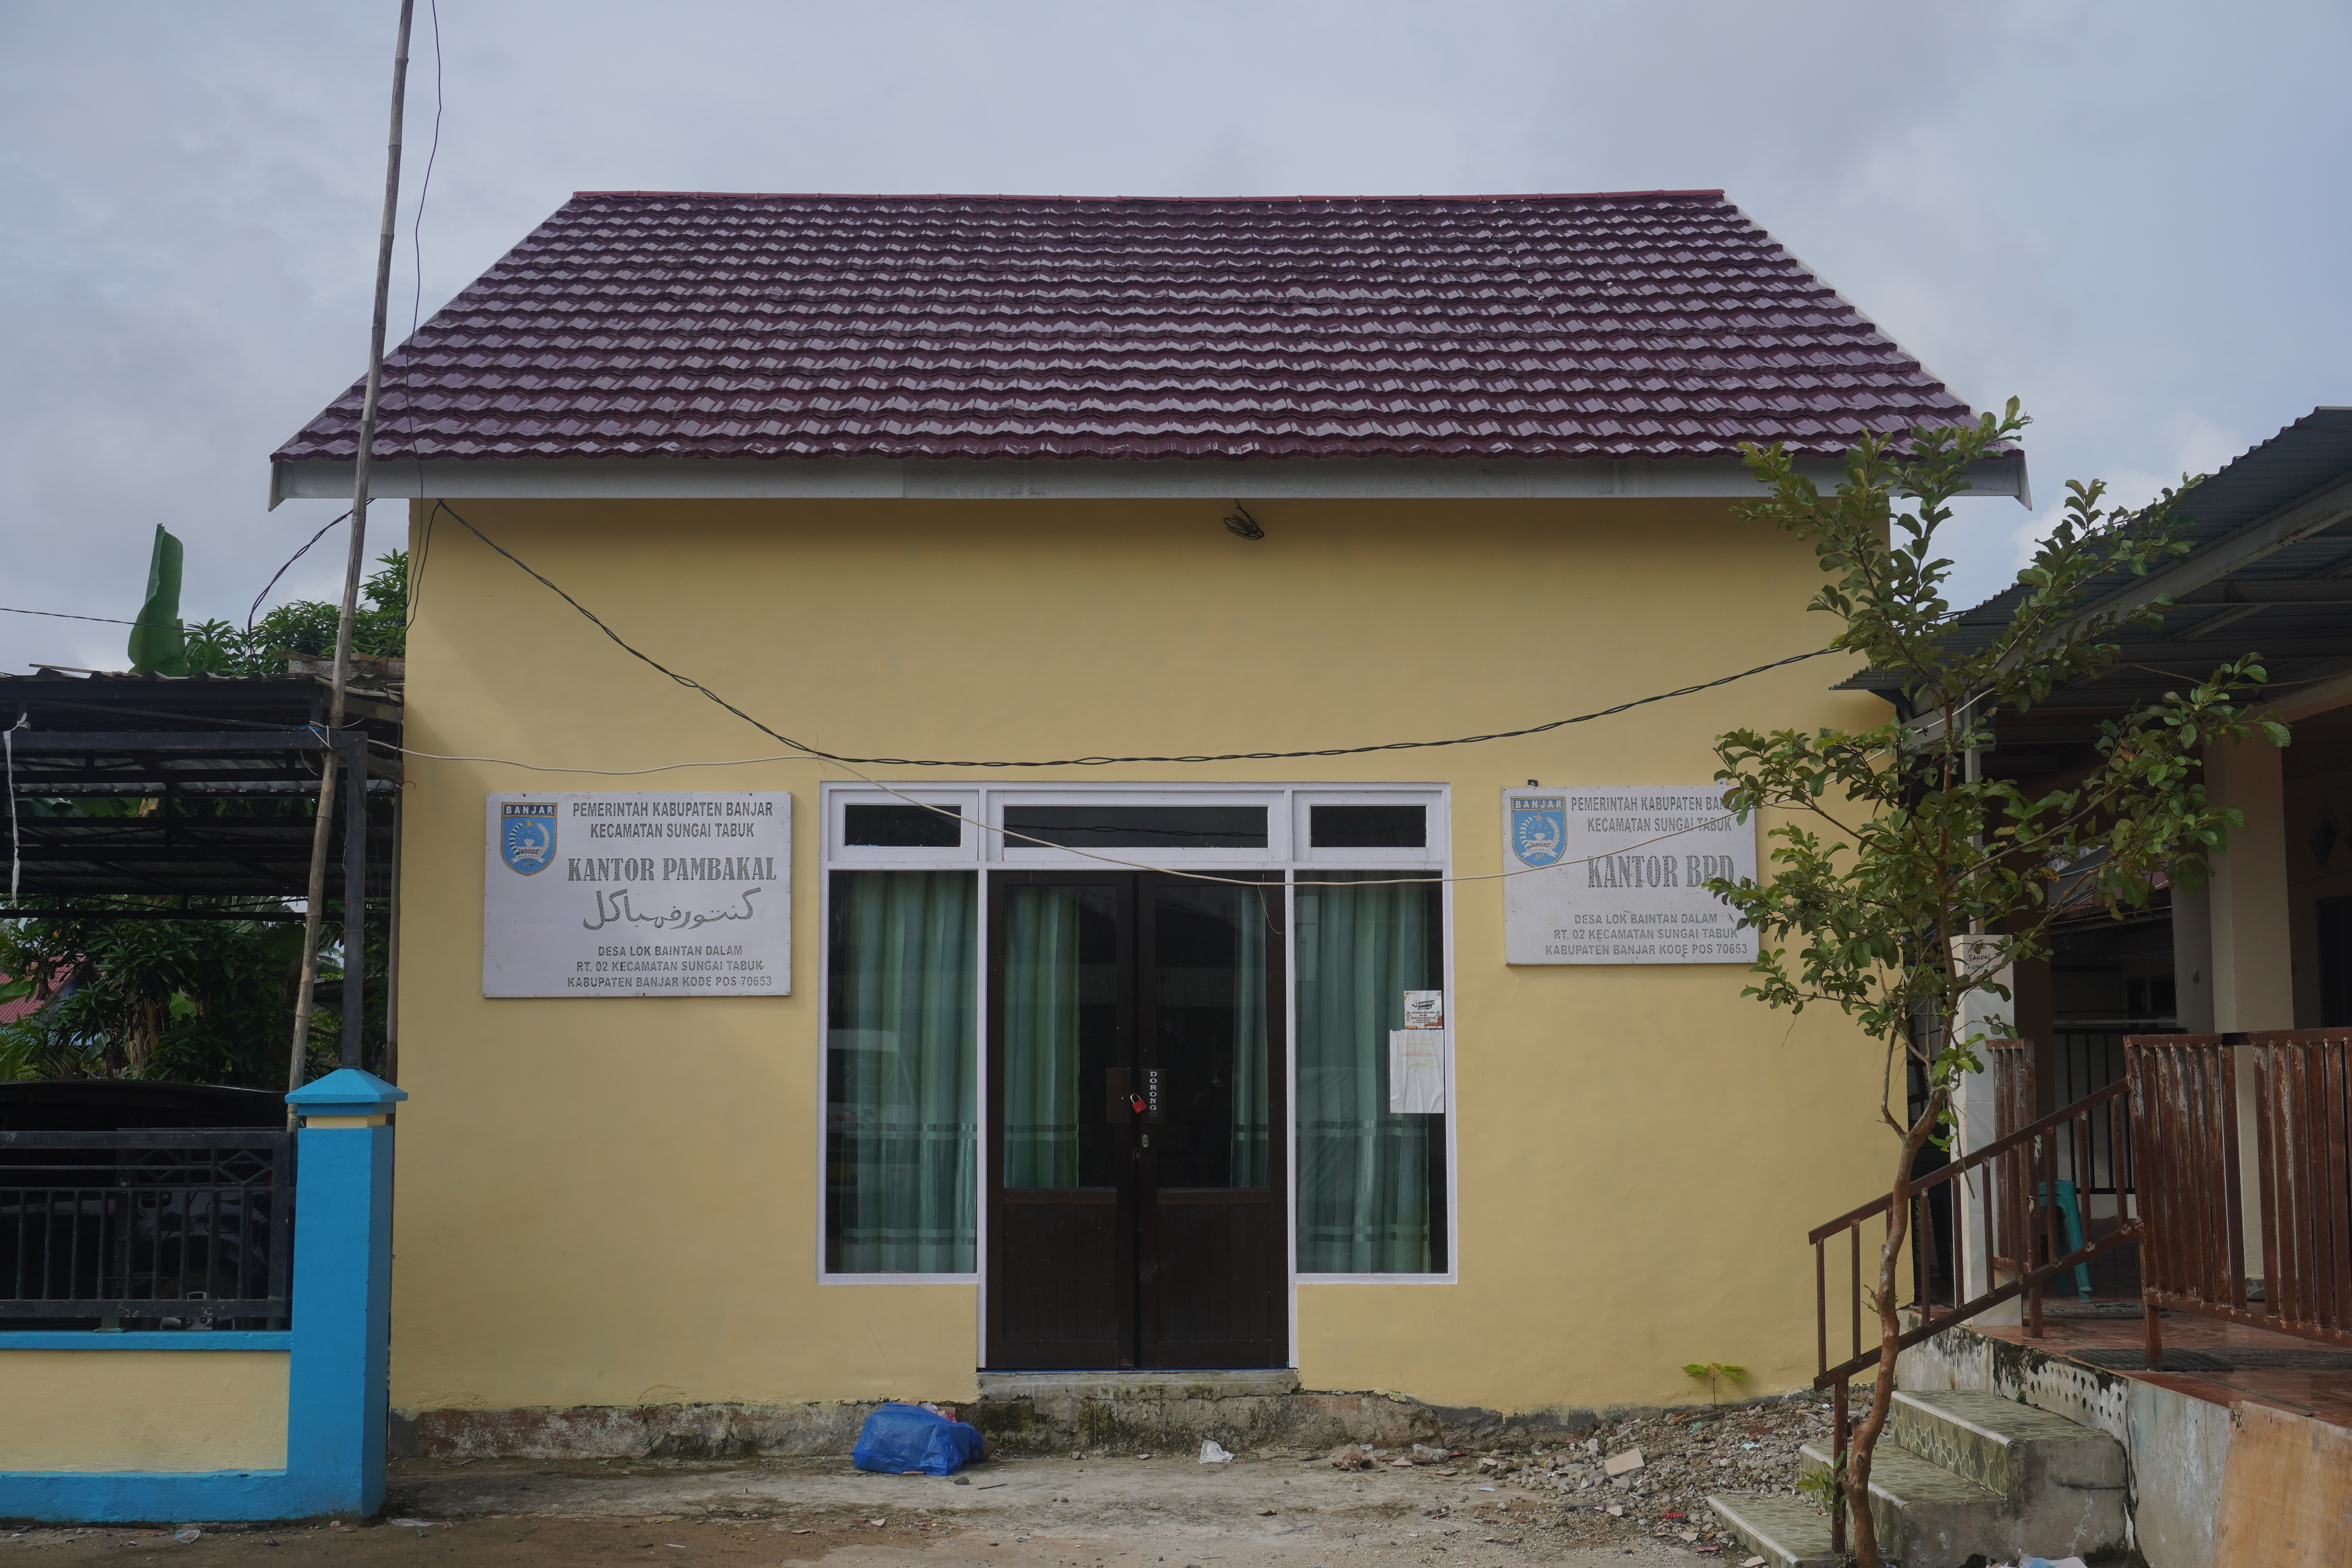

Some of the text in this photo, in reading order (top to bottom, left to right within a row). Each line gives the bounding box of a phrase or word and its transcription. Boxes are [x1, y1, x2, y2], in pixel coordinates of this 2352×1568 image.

[573, 802, 773, 816] PEMERINTAH KABUPATEN BANJAR
[1515, 800, 1562, 809] BANJAR
[1572, 797, 1637, 811] PEMERINTAH
[1642, 797, 1702, 810] KABUPATEN
[505, 806, 554, 815] BANJAR
[1588, 816, 1732, 832] KECAMATAN SUNGAI TABUK
[591, 823, 754, 838] KECAMATAN SUNGAI TABUK
[568, 858, 777, 881] KANTOR PAMBAKAL
[1586, 855, 1734, 888] KANTOR BPD
[1575, 914, 1717, 924] DESA LOK BAINTAN DALAM
[1555, 928, 1739, 940] RT. 02 KECAMATAN SUNGAI TABUK
[599, 946, 742, 956] DESA LOK BAINTAN DALAM
[1546, 944, 1747, 955] KABUPATEN BANJAR KODE POS 70653
[577, 961, 764, 971] RT. 02 KECAMATAN SUNGAI TABUK
[568, 976, 771, 987] KABUPATEN BANJAR KODE POS 70653
[1149, 1071, 1158, 1110] DORONG
